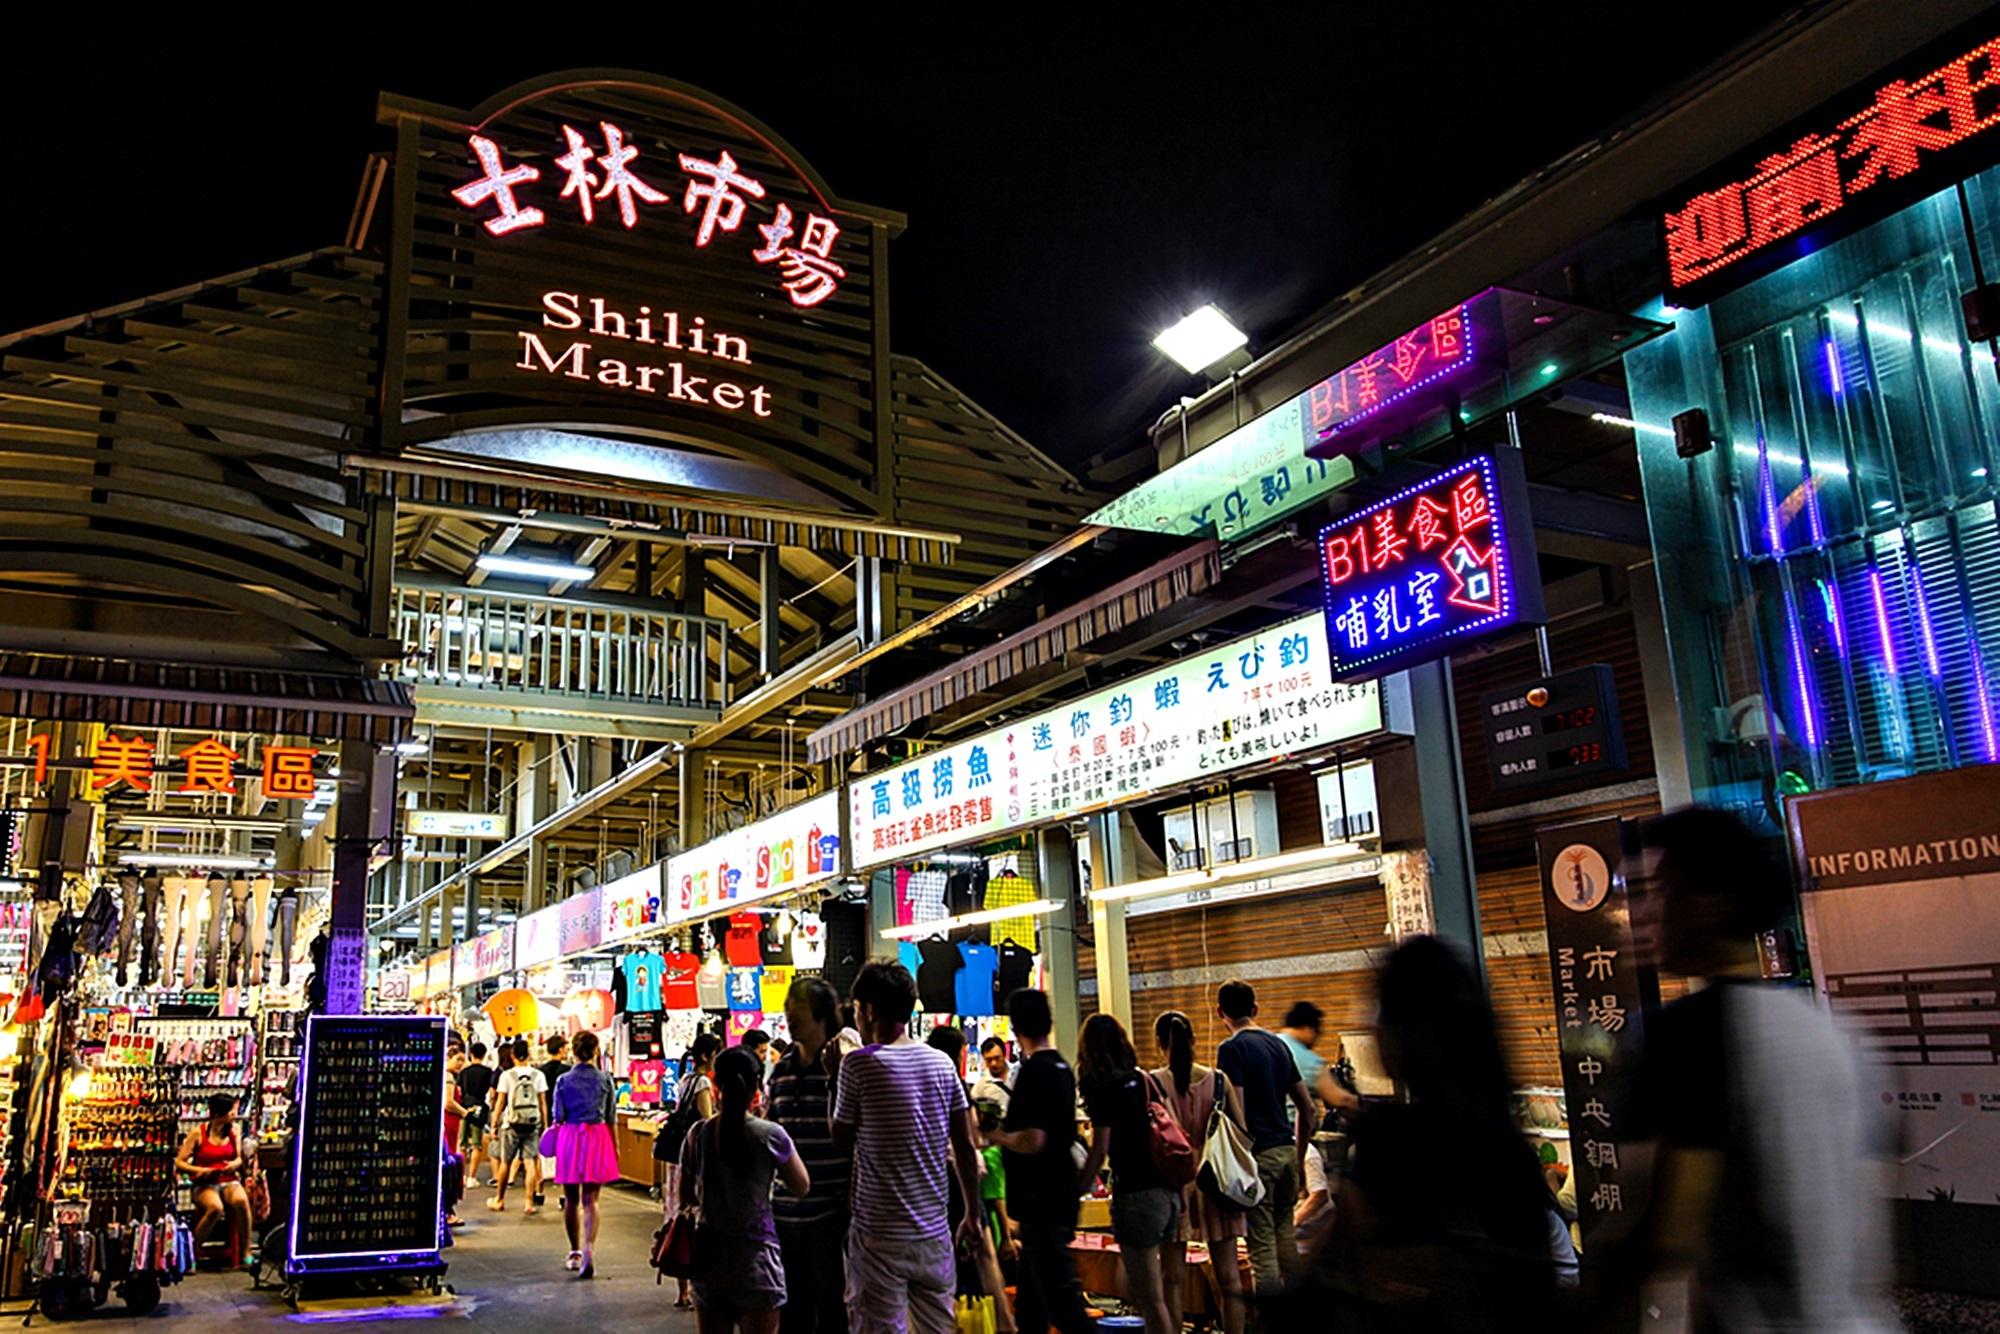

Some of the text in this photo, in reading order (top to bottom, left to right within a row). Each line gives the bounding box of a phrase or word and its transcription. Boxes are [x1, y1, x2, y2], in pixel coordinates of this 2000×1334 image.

[451, 121, 847, 307] 士林市場
[542, 291, 752, 364] Shilin
[516, 331, 772, 417] Market
[1327, 475, 1491, 585] B1美食區
[1336, 569, 1441, 649] 哺乳室
[1454, 547, 1489, 600] 入口
[871, 746, 992, 819] 高級撈魚
[756, 824, 821, 888] Spot
[1809, 834, 2000, 877] INFORMATION
[1557, 948, 1582, 1028] Market
[1583, 945, 1626, 1032] 市場
